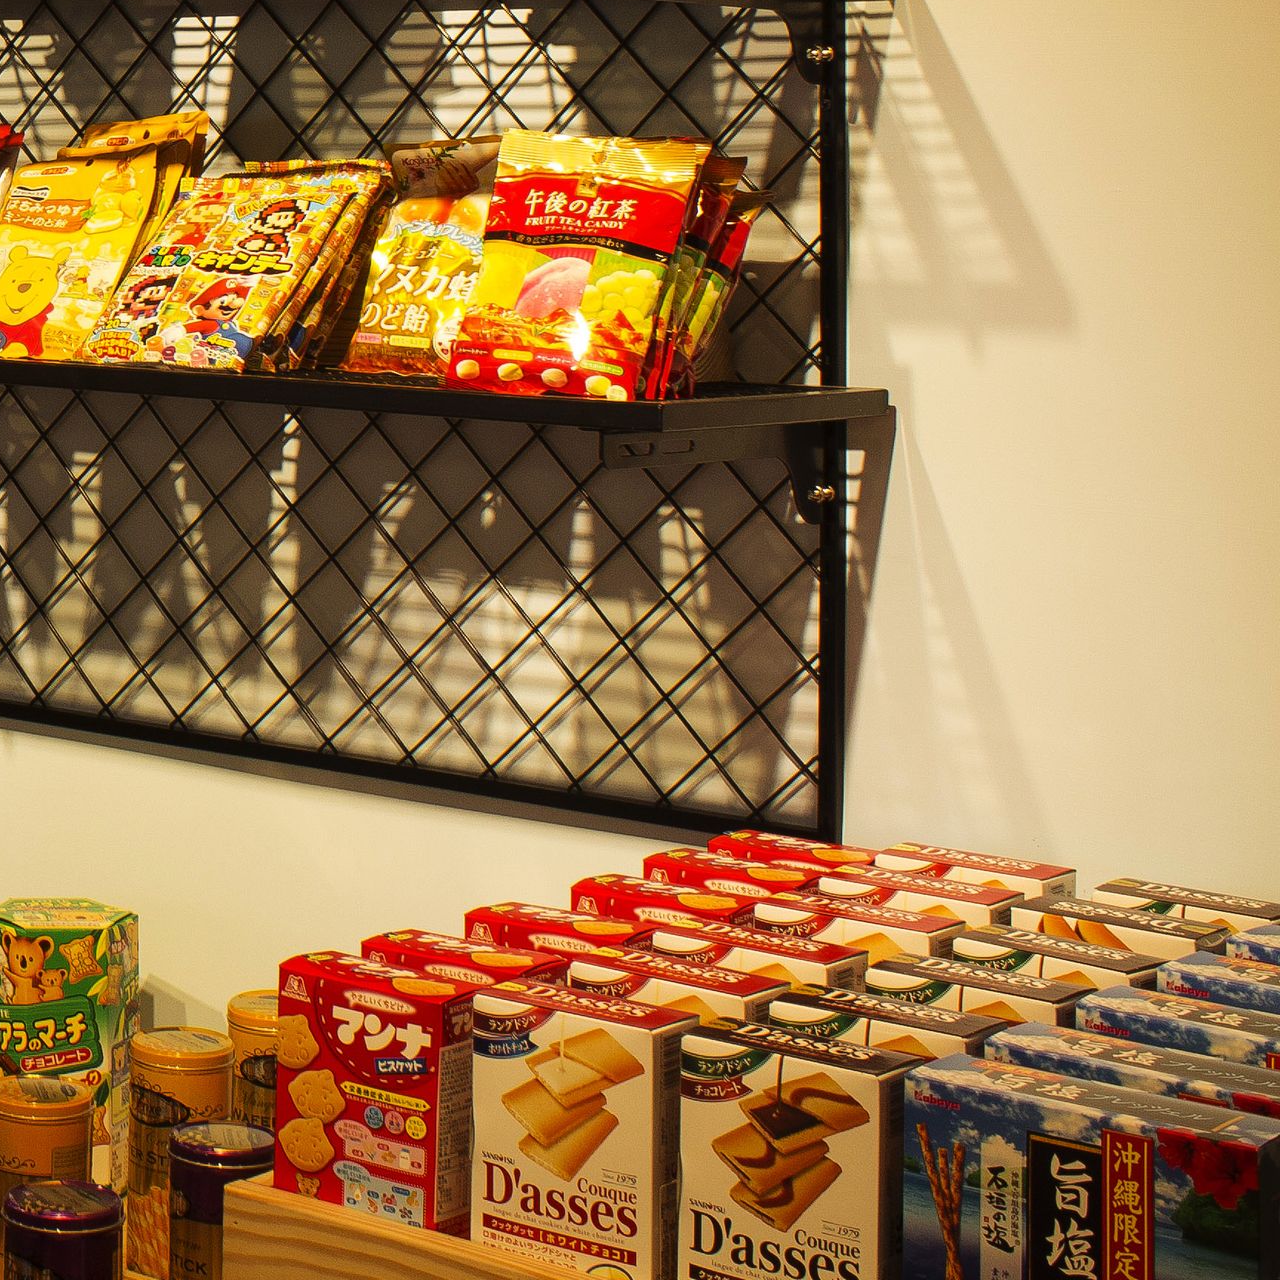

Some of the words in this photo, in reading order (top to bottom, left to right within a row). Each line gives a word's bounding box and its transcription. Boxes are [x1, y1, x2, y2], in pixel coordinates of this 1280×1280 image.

[524, 188, 639, 220] 午後の紅茶
[524, 216, 558, 226] FRUIT
[560, 217, 582, 227] TEA
[584, 221, 627, 230] CANDY
[140, 254, 192, 267] MARIO
[151, 245, 195, 257] SUPER
[194, 251, 293, 273] キャンデー
[359, 302, 430, 334] のど飴
[525, 984, 650, 1018] D'asses
[332, 1005, 432, 1060] マンナ
[488, 1015, 538, 1032] ラングドシャ
[1085, 1018, 1131, 1037] Kabaya
[24, 1050, 89, 1069] チョコレート
[376, 1058, 424, 1074] ビスケット
[697, 1057, 752, 1073] ラングドシャ
[694, 1082, 742, 1098] チョコレート
[914, 1088, 962, 1111] Kabaya
[616, 1172, 638, 1186] 1979
[482, 1160, 638, 1238] D'asses
[577, 1177, 638, 1205] Couque
[982, 1165, 1017, 1254] 石垣の塩
[1045, 1152, 1097, 1280] 旨塩
[1112, 1140, 1144, 1280] 沖縄限定
[794, 1228, 861, 1259] Couque
[837, 1226, 861, 1239] 1979
[688, 1208, 861, 1280] D'asses
